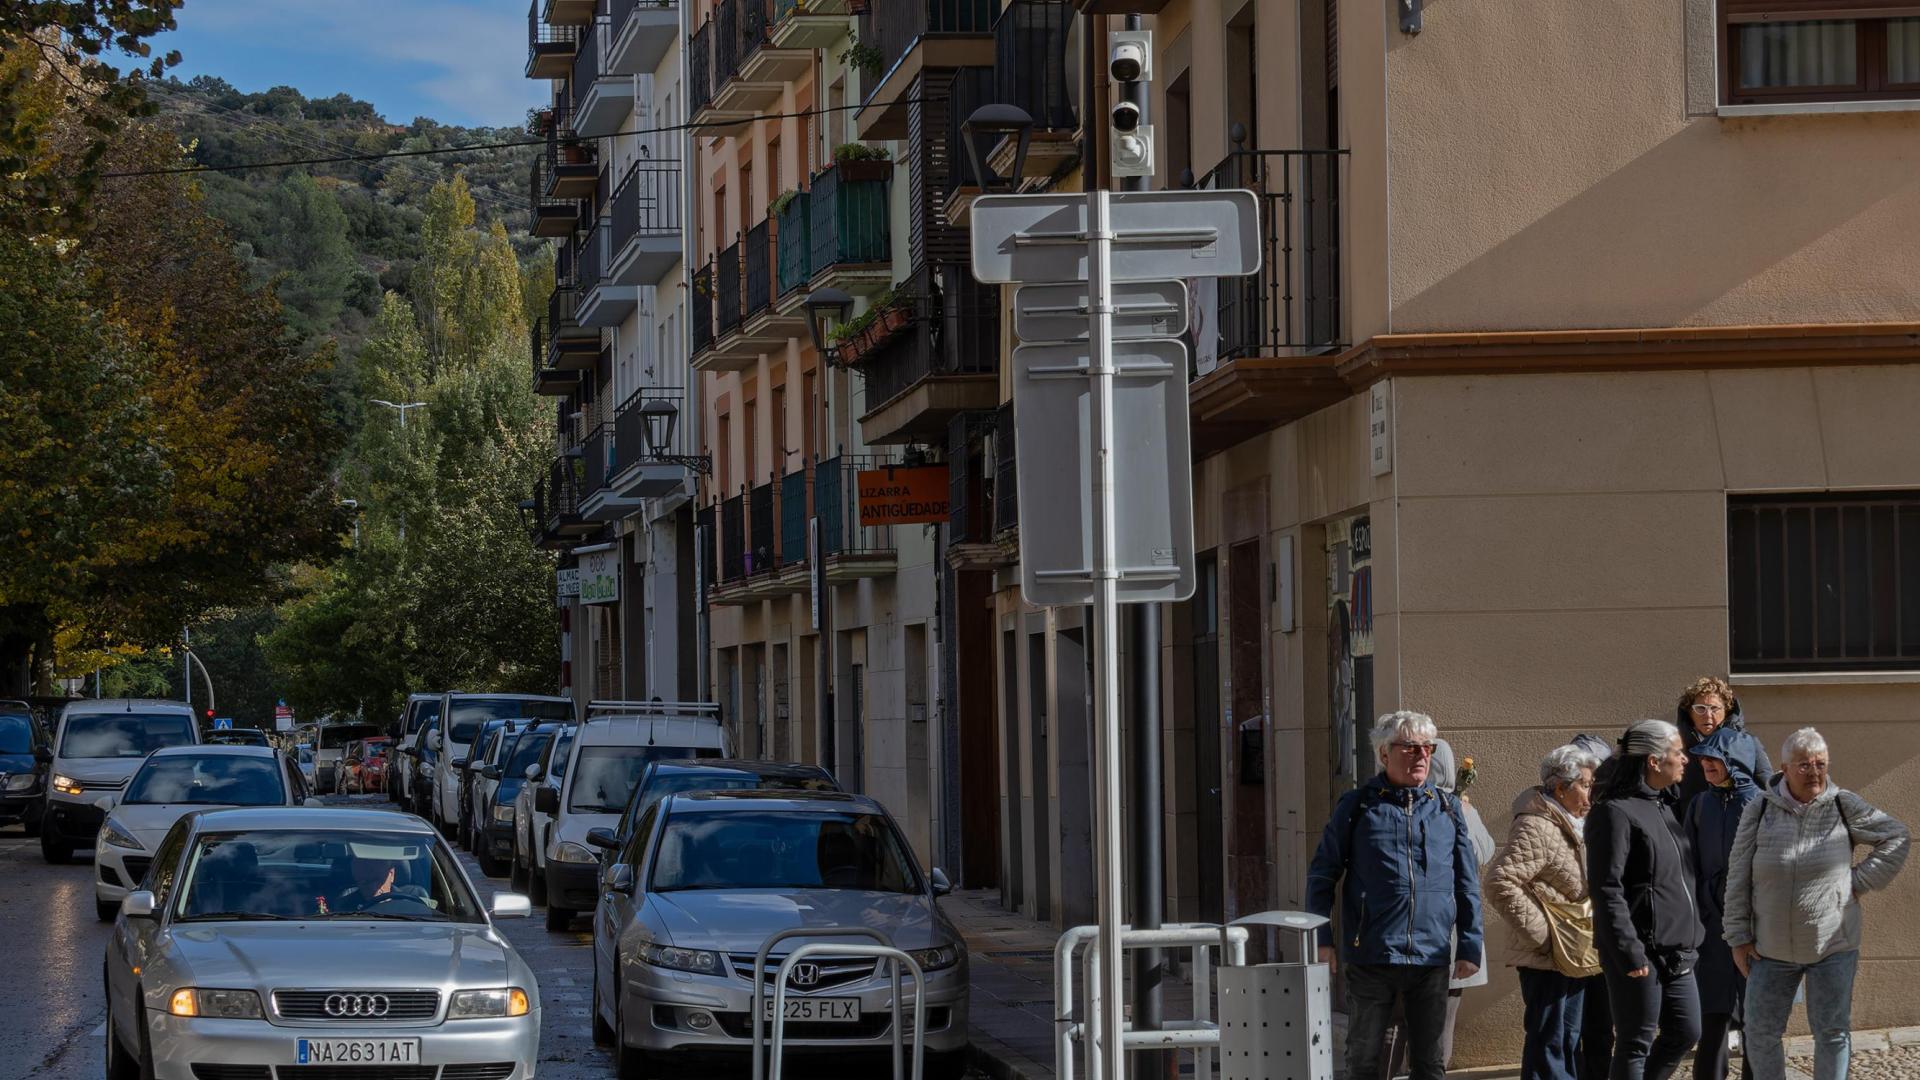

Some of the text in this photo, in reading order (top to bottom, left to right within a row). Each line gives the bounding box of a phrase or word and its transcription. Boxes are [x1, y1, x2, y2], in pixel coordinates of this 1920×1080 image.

[860, 486, 911, 498] LIZARRA
[861, 500, 950, 519] ANTIGÜEDADE
[819, 1001, 853, 1019] FLX
[308, 1042, 414, 1062] NA2631AT
